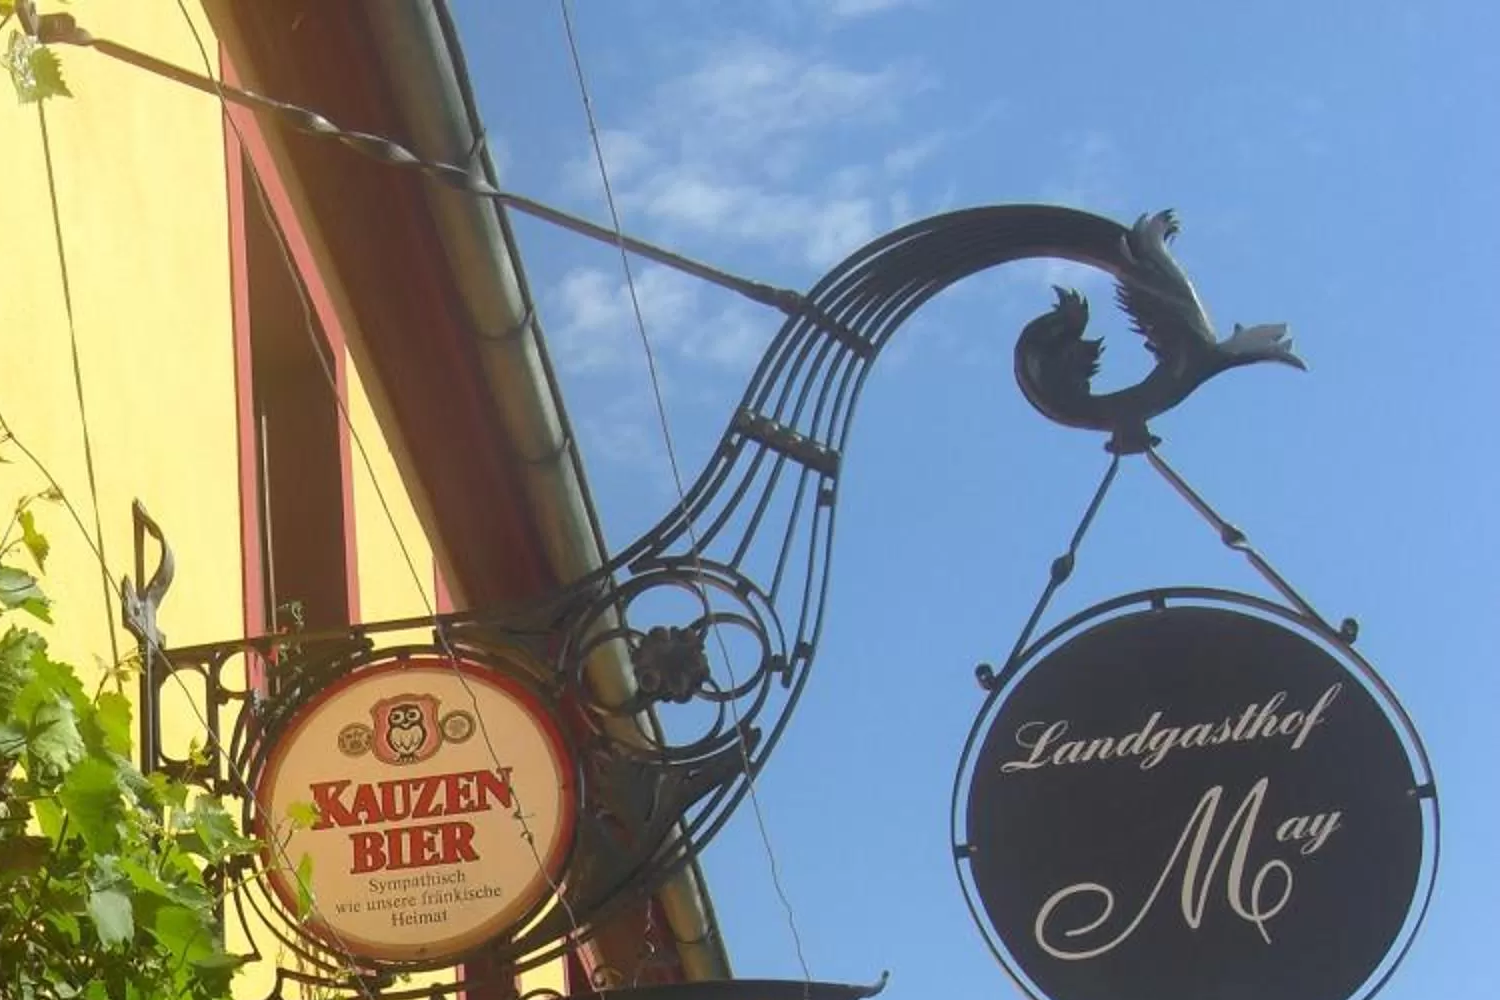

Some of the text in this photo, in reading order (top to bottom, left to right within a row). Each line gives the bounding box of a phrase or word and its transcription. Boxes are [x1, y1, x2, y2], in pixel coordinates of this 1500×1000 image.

[1001, 682, 1343, 772] Landgasthof
[310, 766, 513, 830] KAUZEN
[349, 821, 479, 874] BIER
[1035, 776, 1343, 960] May
[335, 884, 502, 914] wie unsere fränkische
[368, 870, 466, 894] Sympathisch
[391, 908, 449, 927] Heimat
